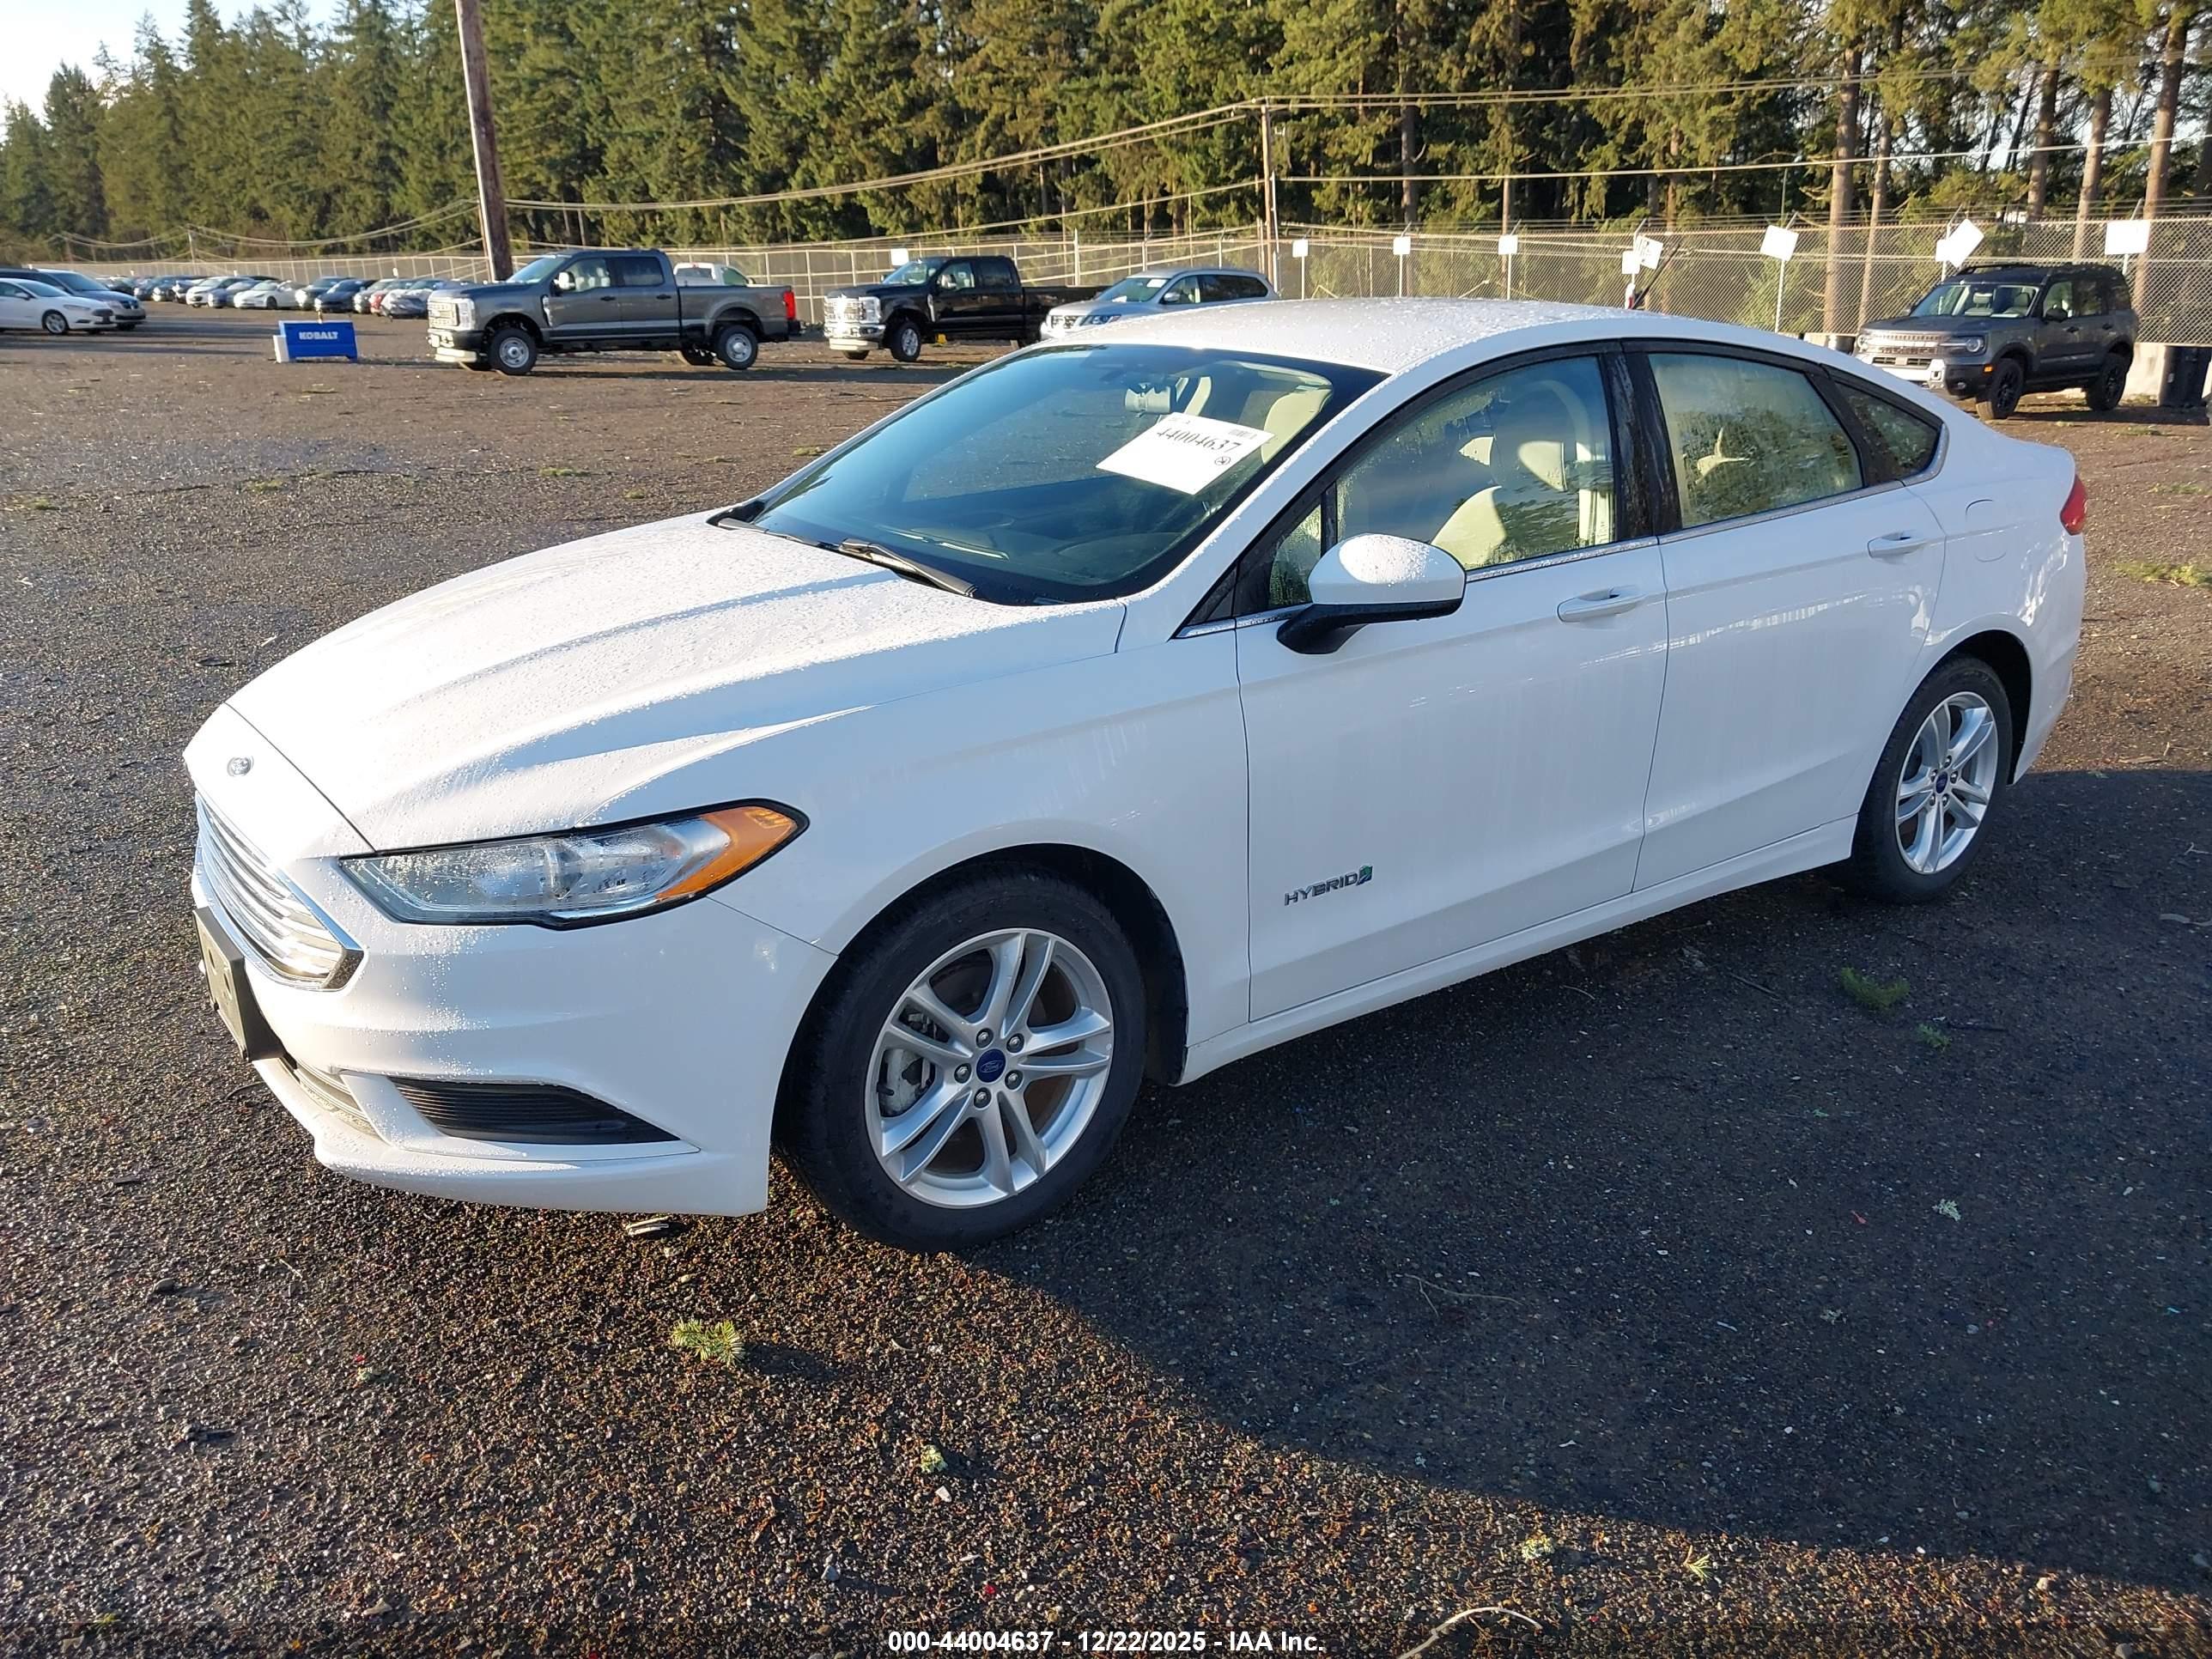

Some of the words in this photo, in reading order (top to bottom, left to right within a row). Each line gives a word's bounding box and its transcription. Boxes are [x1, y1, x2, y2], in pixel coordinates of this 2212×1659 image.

[298, 331, 339, 341] KOBALT
[1157, 428, 1243, 453] 44004637
[1284, 871, 1358, 907] HYBRID
